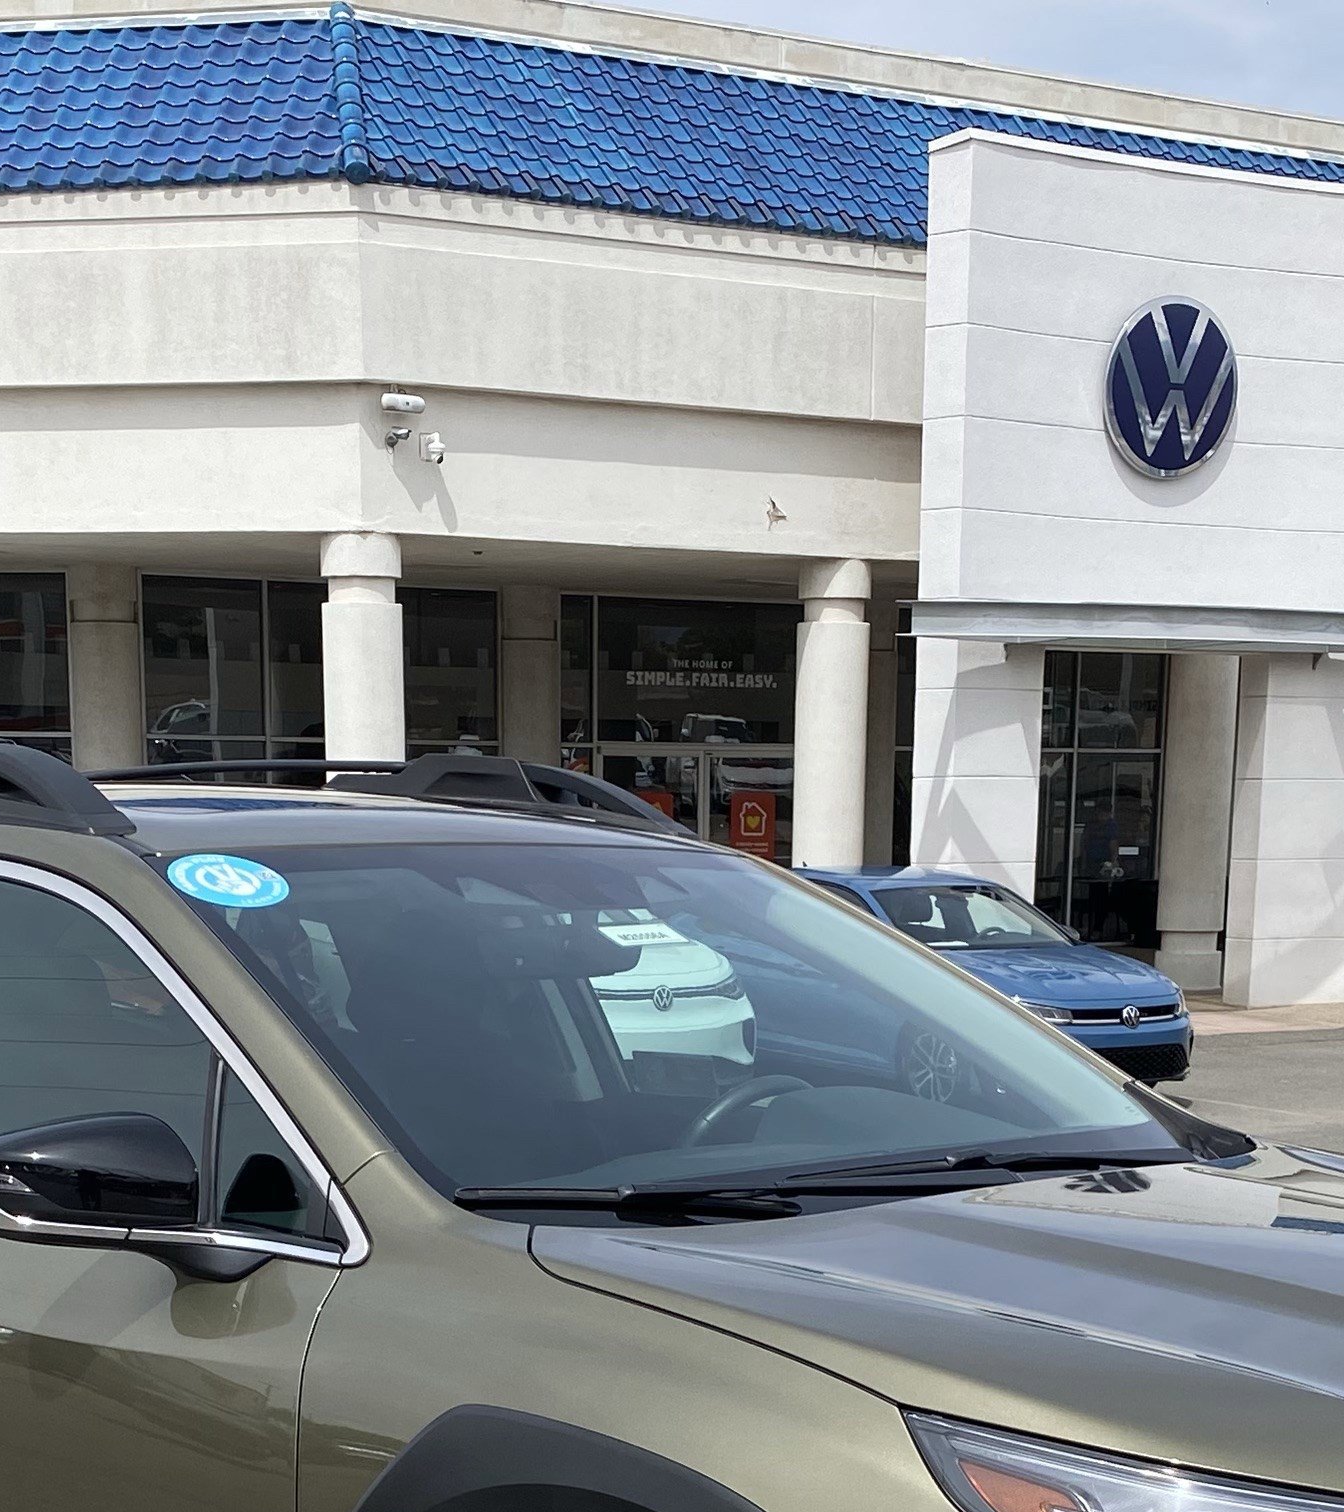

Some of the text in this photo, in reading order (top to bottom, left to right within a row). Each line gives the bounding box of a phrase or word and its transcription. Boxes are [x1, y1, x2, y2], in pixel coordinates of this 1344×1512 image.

[1113, 303, 1237, 464] VW
[672, 659, 733, 669] THE HOME OF
